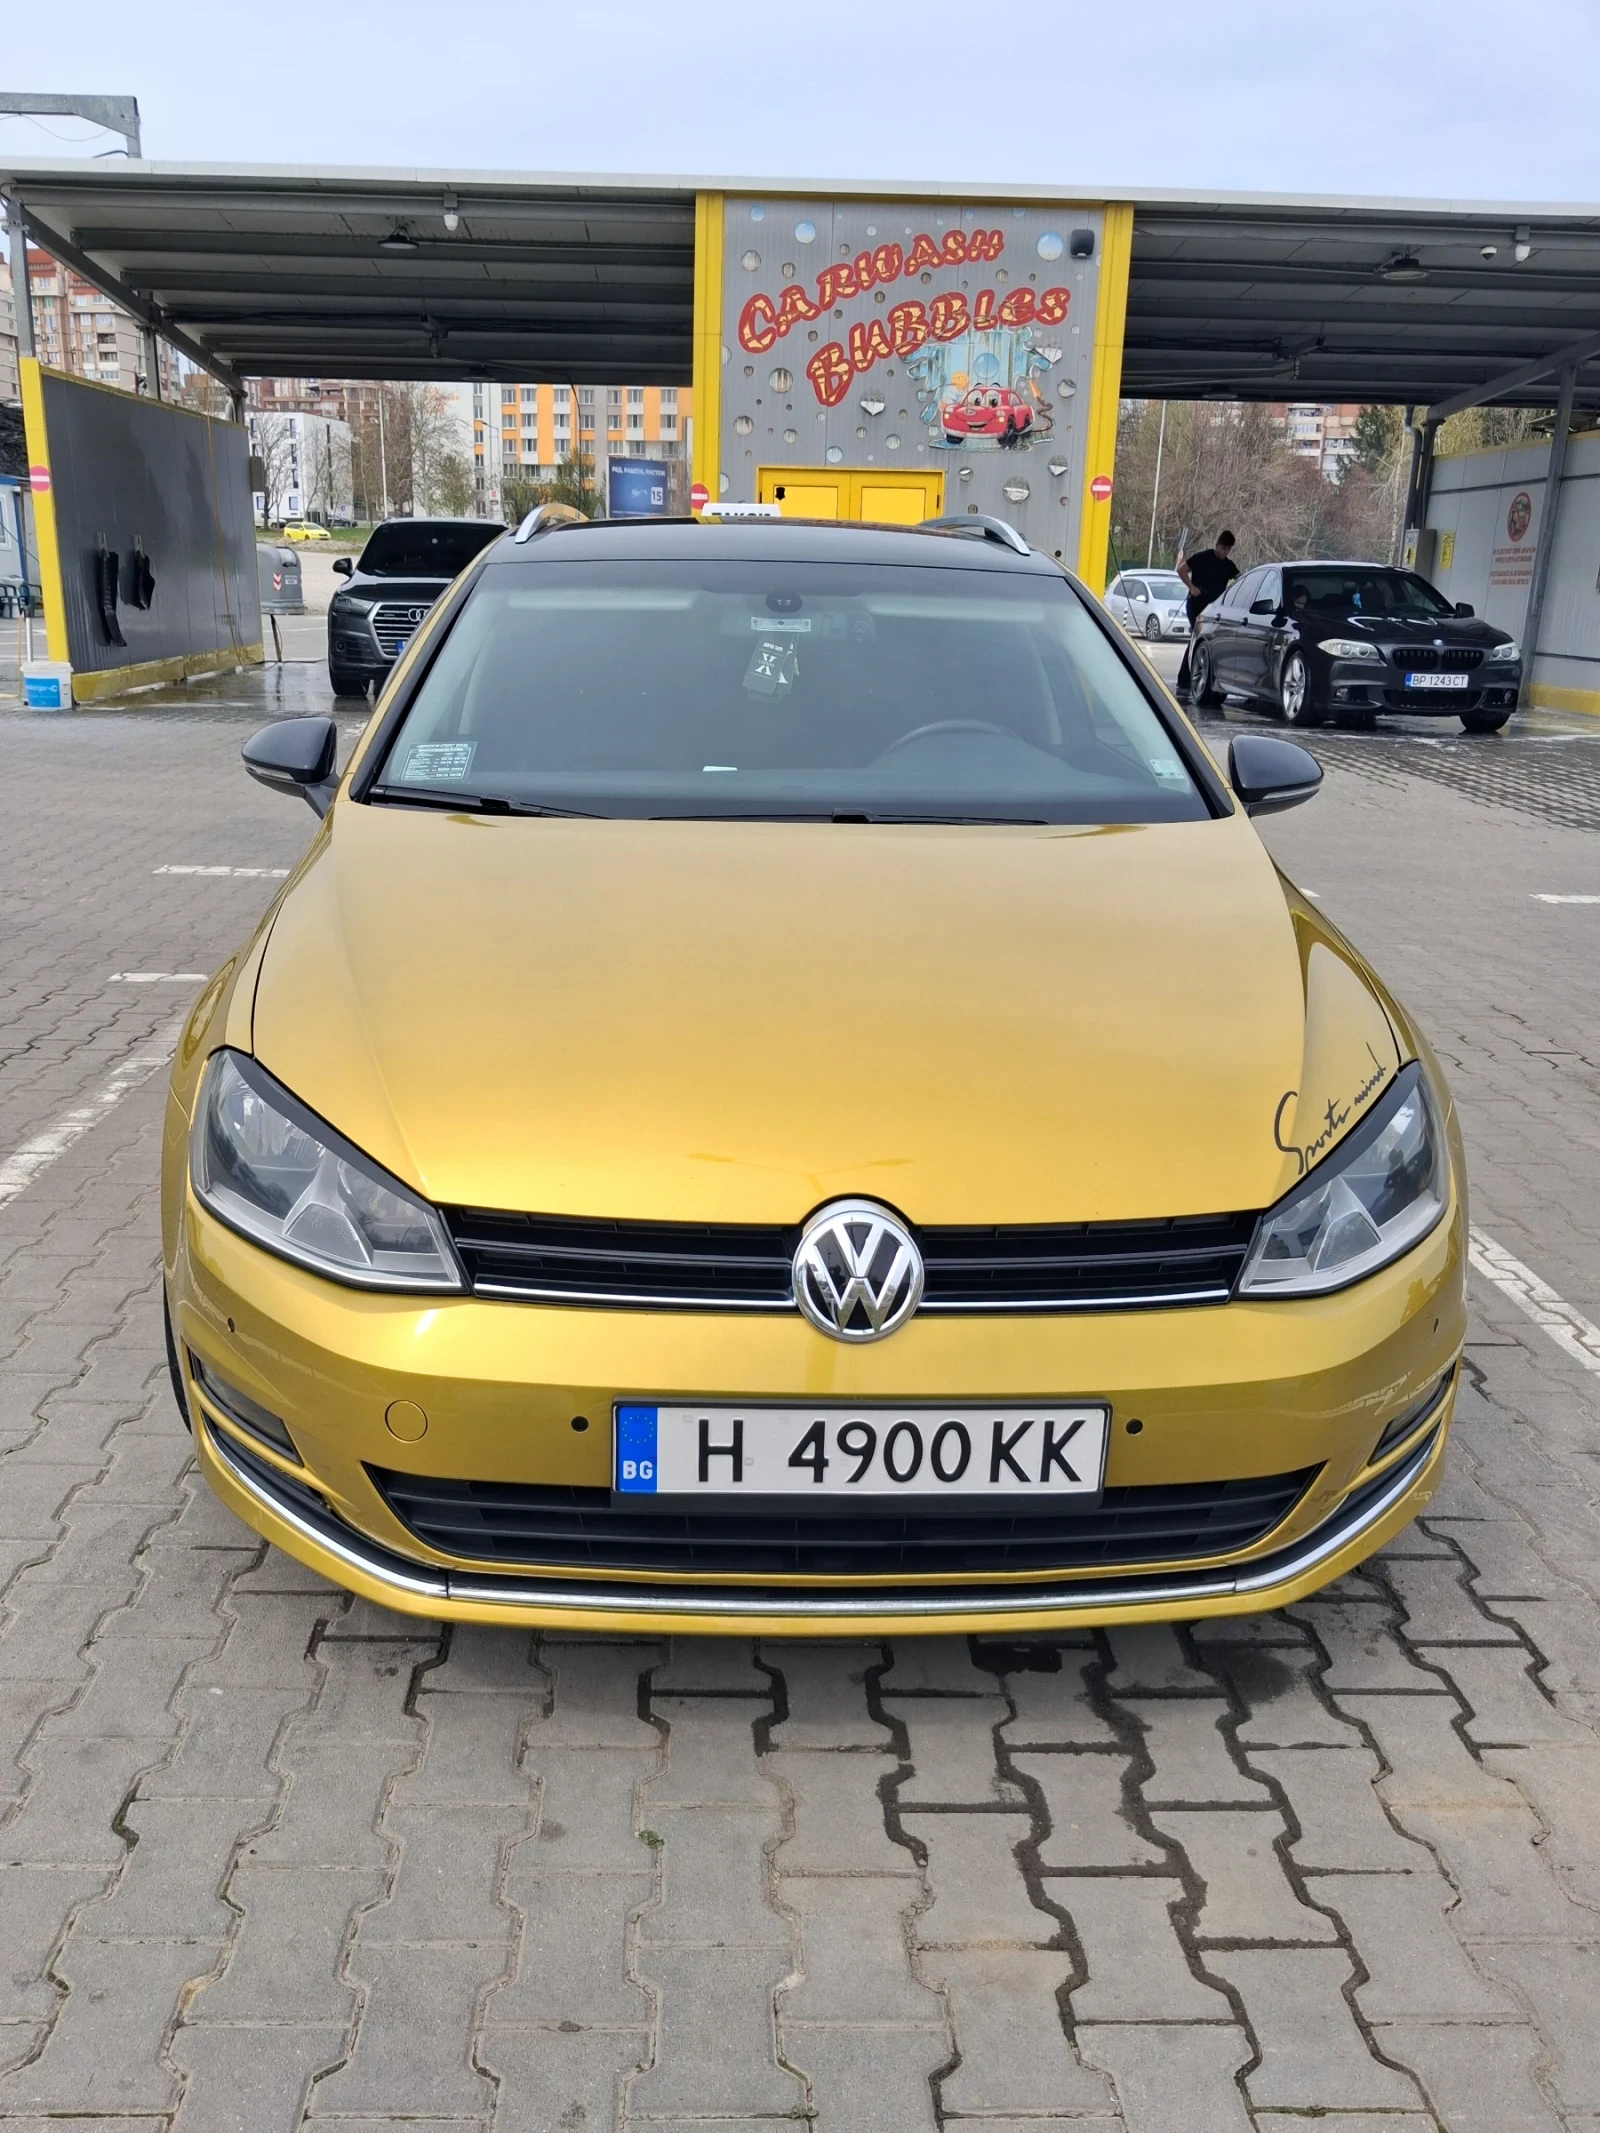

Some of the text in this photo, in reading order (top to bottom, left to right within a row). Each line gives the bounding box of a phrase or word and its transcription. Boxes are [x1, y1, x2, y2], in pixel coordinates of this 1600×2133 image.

[738, 229, 1005, 354] CARWASH
[806, 286, 1071, 407] BUBBLES
[651, 490, 662, 502] 15
[1412, 675, 1427, 686] BP
[622, 1460, 653, 1479] BG
[698, 1419, 744, 1483] H
